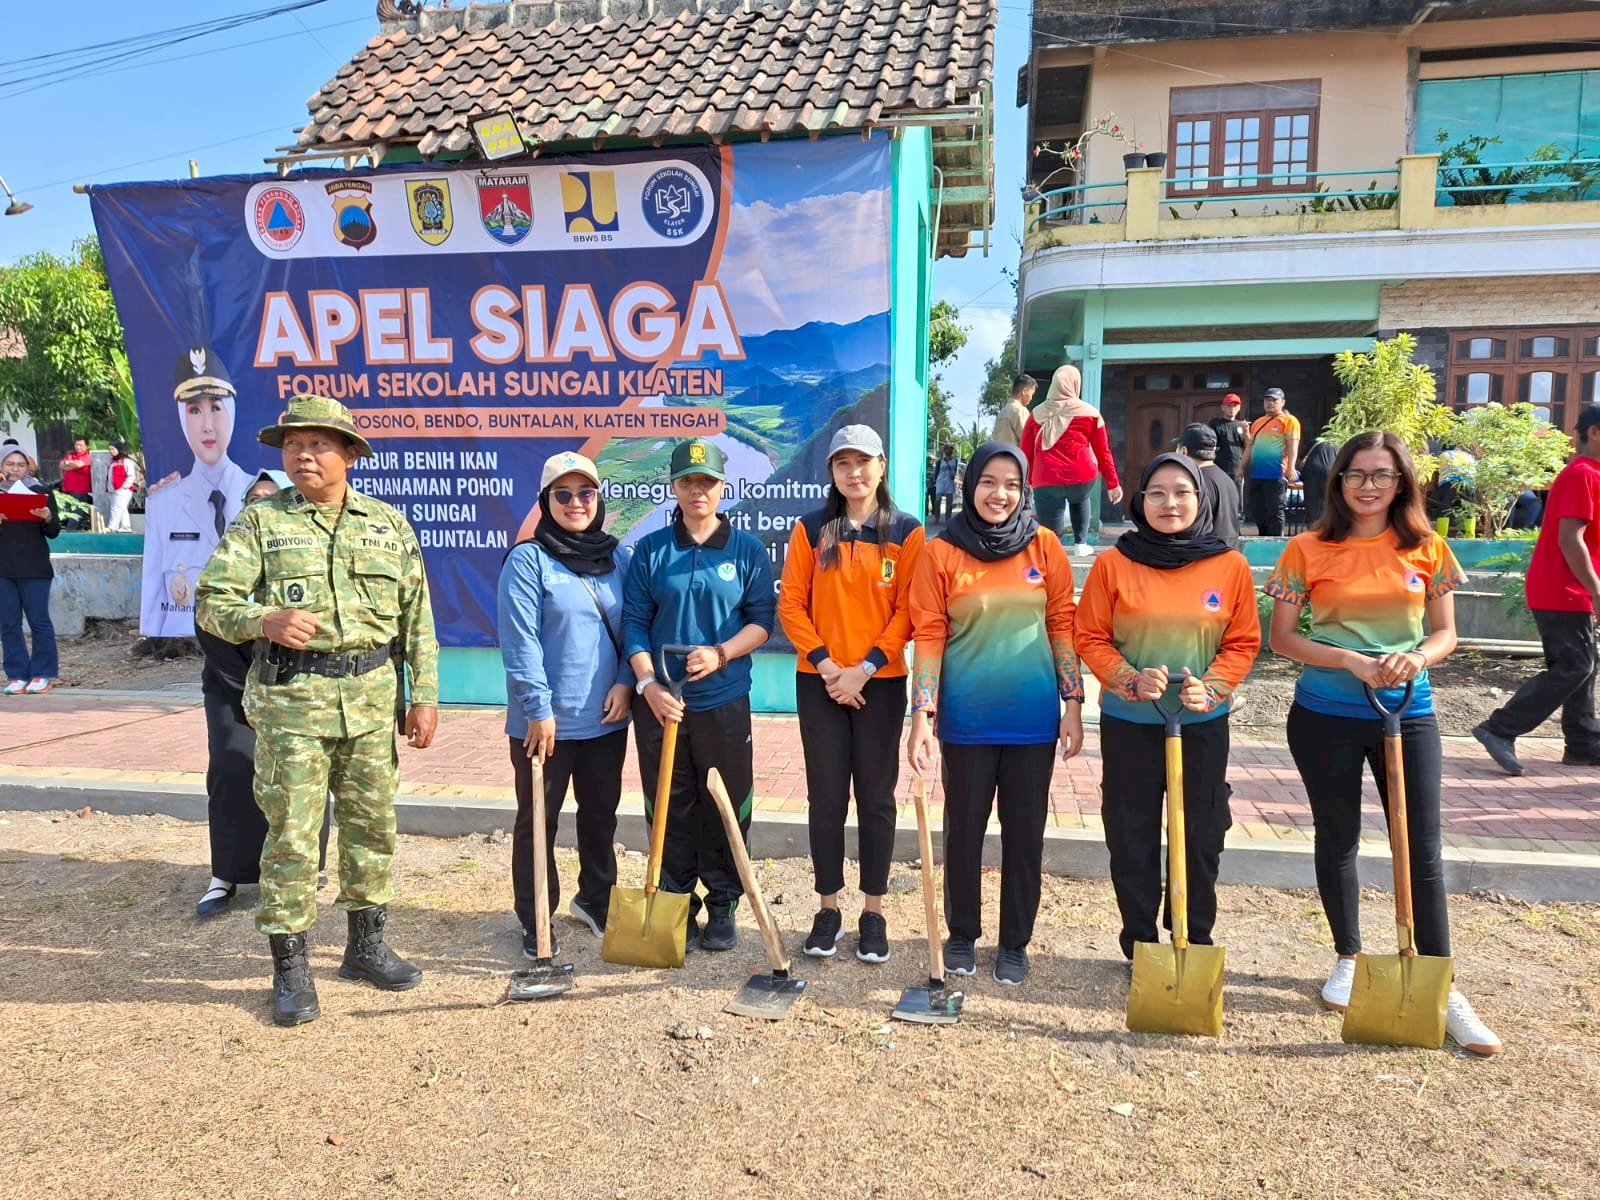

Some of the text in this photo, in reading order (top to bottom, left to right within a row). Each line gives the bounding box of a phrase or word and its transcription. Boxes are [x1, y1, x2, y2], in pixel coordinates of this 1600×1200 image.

[343, 182, 371, 191] TENGAH
[478, 176, 528, 187] MATARAM
[644, 170, 701, 200] FORUM SEKOLAH SUNGAI
[573, 234, 613, 243] BBWS BS
[666, 228, 684, 236] SSK
[253, 280, 747, 367] APEL SIAGA
[277, 367, 723, 399] FORUM SEKOLAH SUNGAI KLATEN
[424, 414, 482, 430] BENDO,
[488, 413, 579, 430] BUNTALAN,
[583, 413, 645, 428] KLATEN
[650, 412, 719, 428] TENGAH
[404, 451, 454, 470] BENIH
[460, 451, 497, 470] IKAN
[352, 477, 513, 496] PENANAMAN POHON
[412, 503, 476, 522] SUNGAI
[266, 537, 313, 549] BUDIYONO
[360, 538, 398, 552] TNI AD
[421, 529, 508, 548] BUNTALAN
